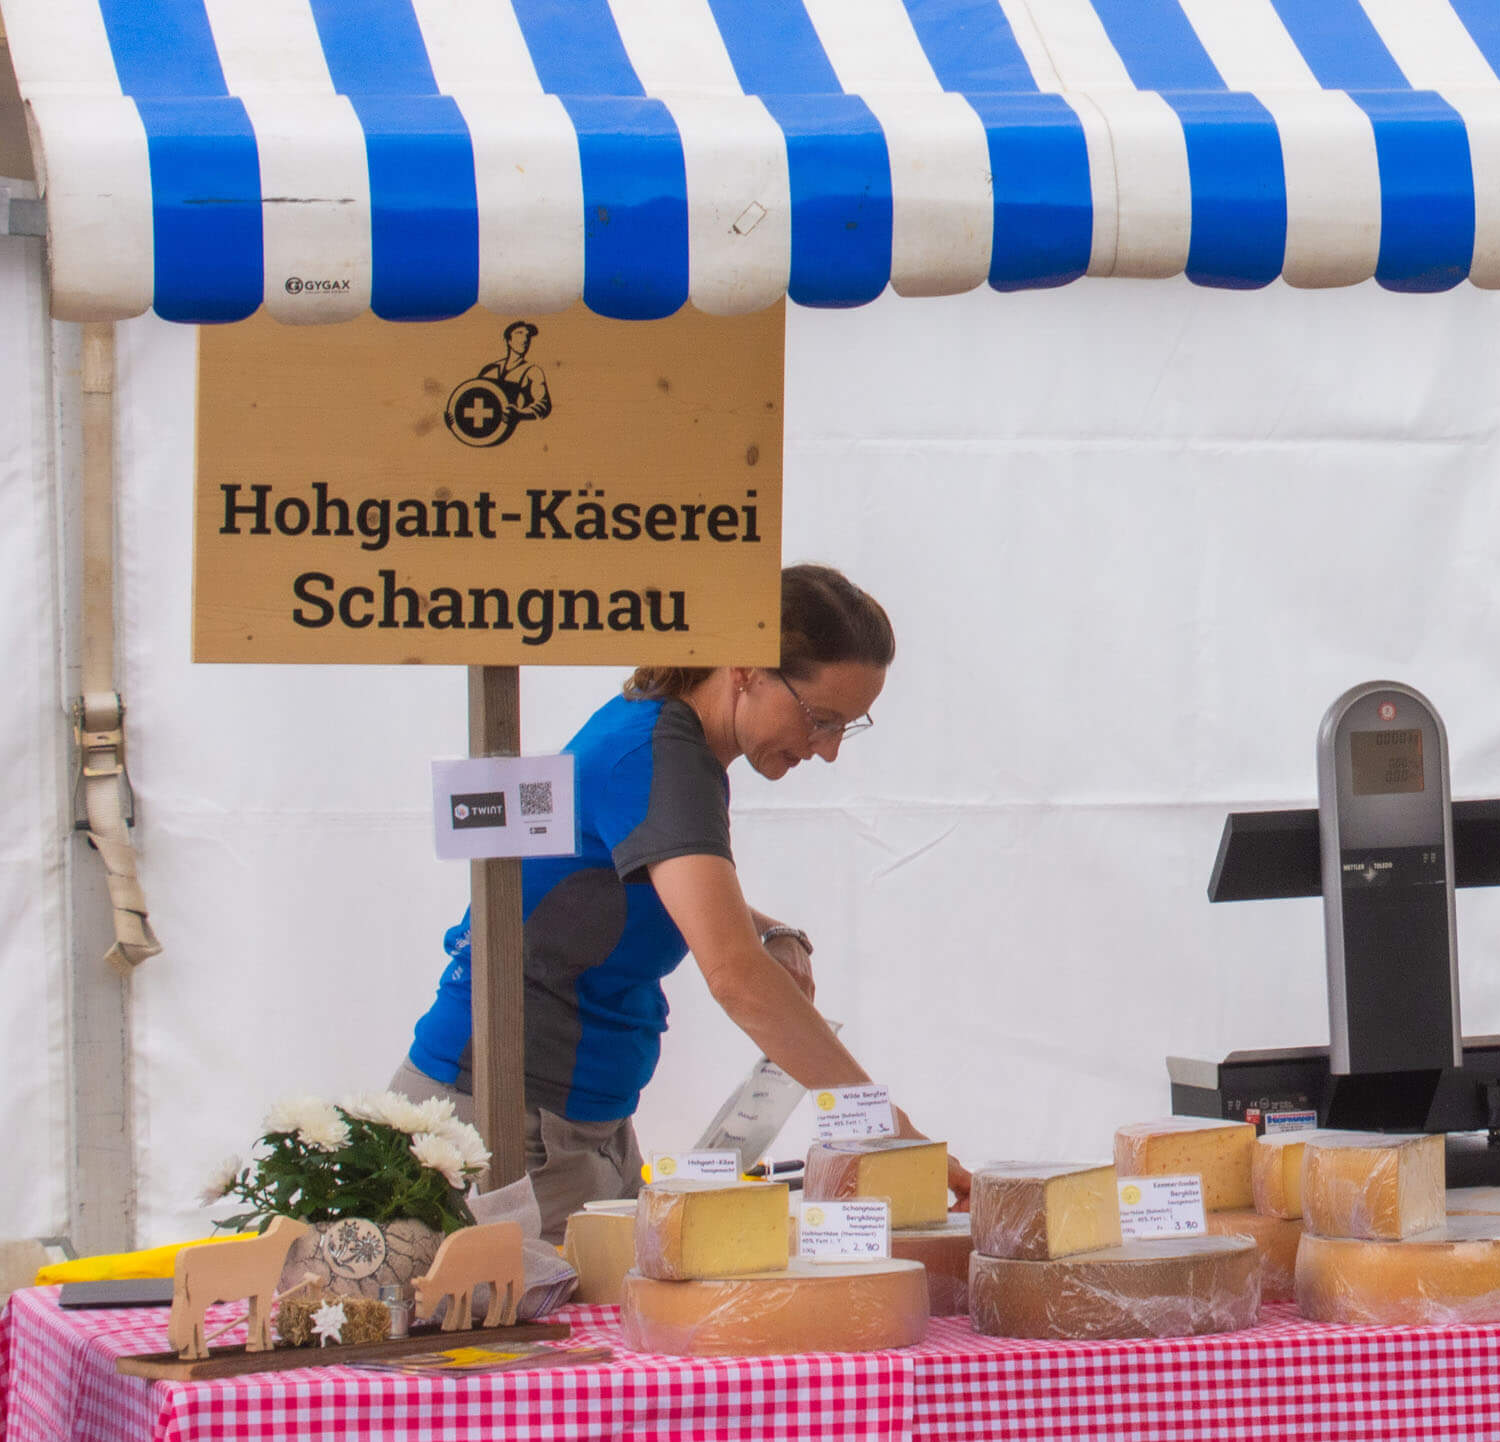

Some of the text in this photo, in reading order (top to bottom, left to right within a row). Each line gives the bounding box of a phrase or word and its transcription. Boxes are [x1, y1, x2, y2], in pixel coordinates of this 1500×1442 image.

[304, 280, 350, 290] GYGAX
[219, 483, 761, 551] Hohgant-Käserei
[292, 569, 690, 645] Schangnau
